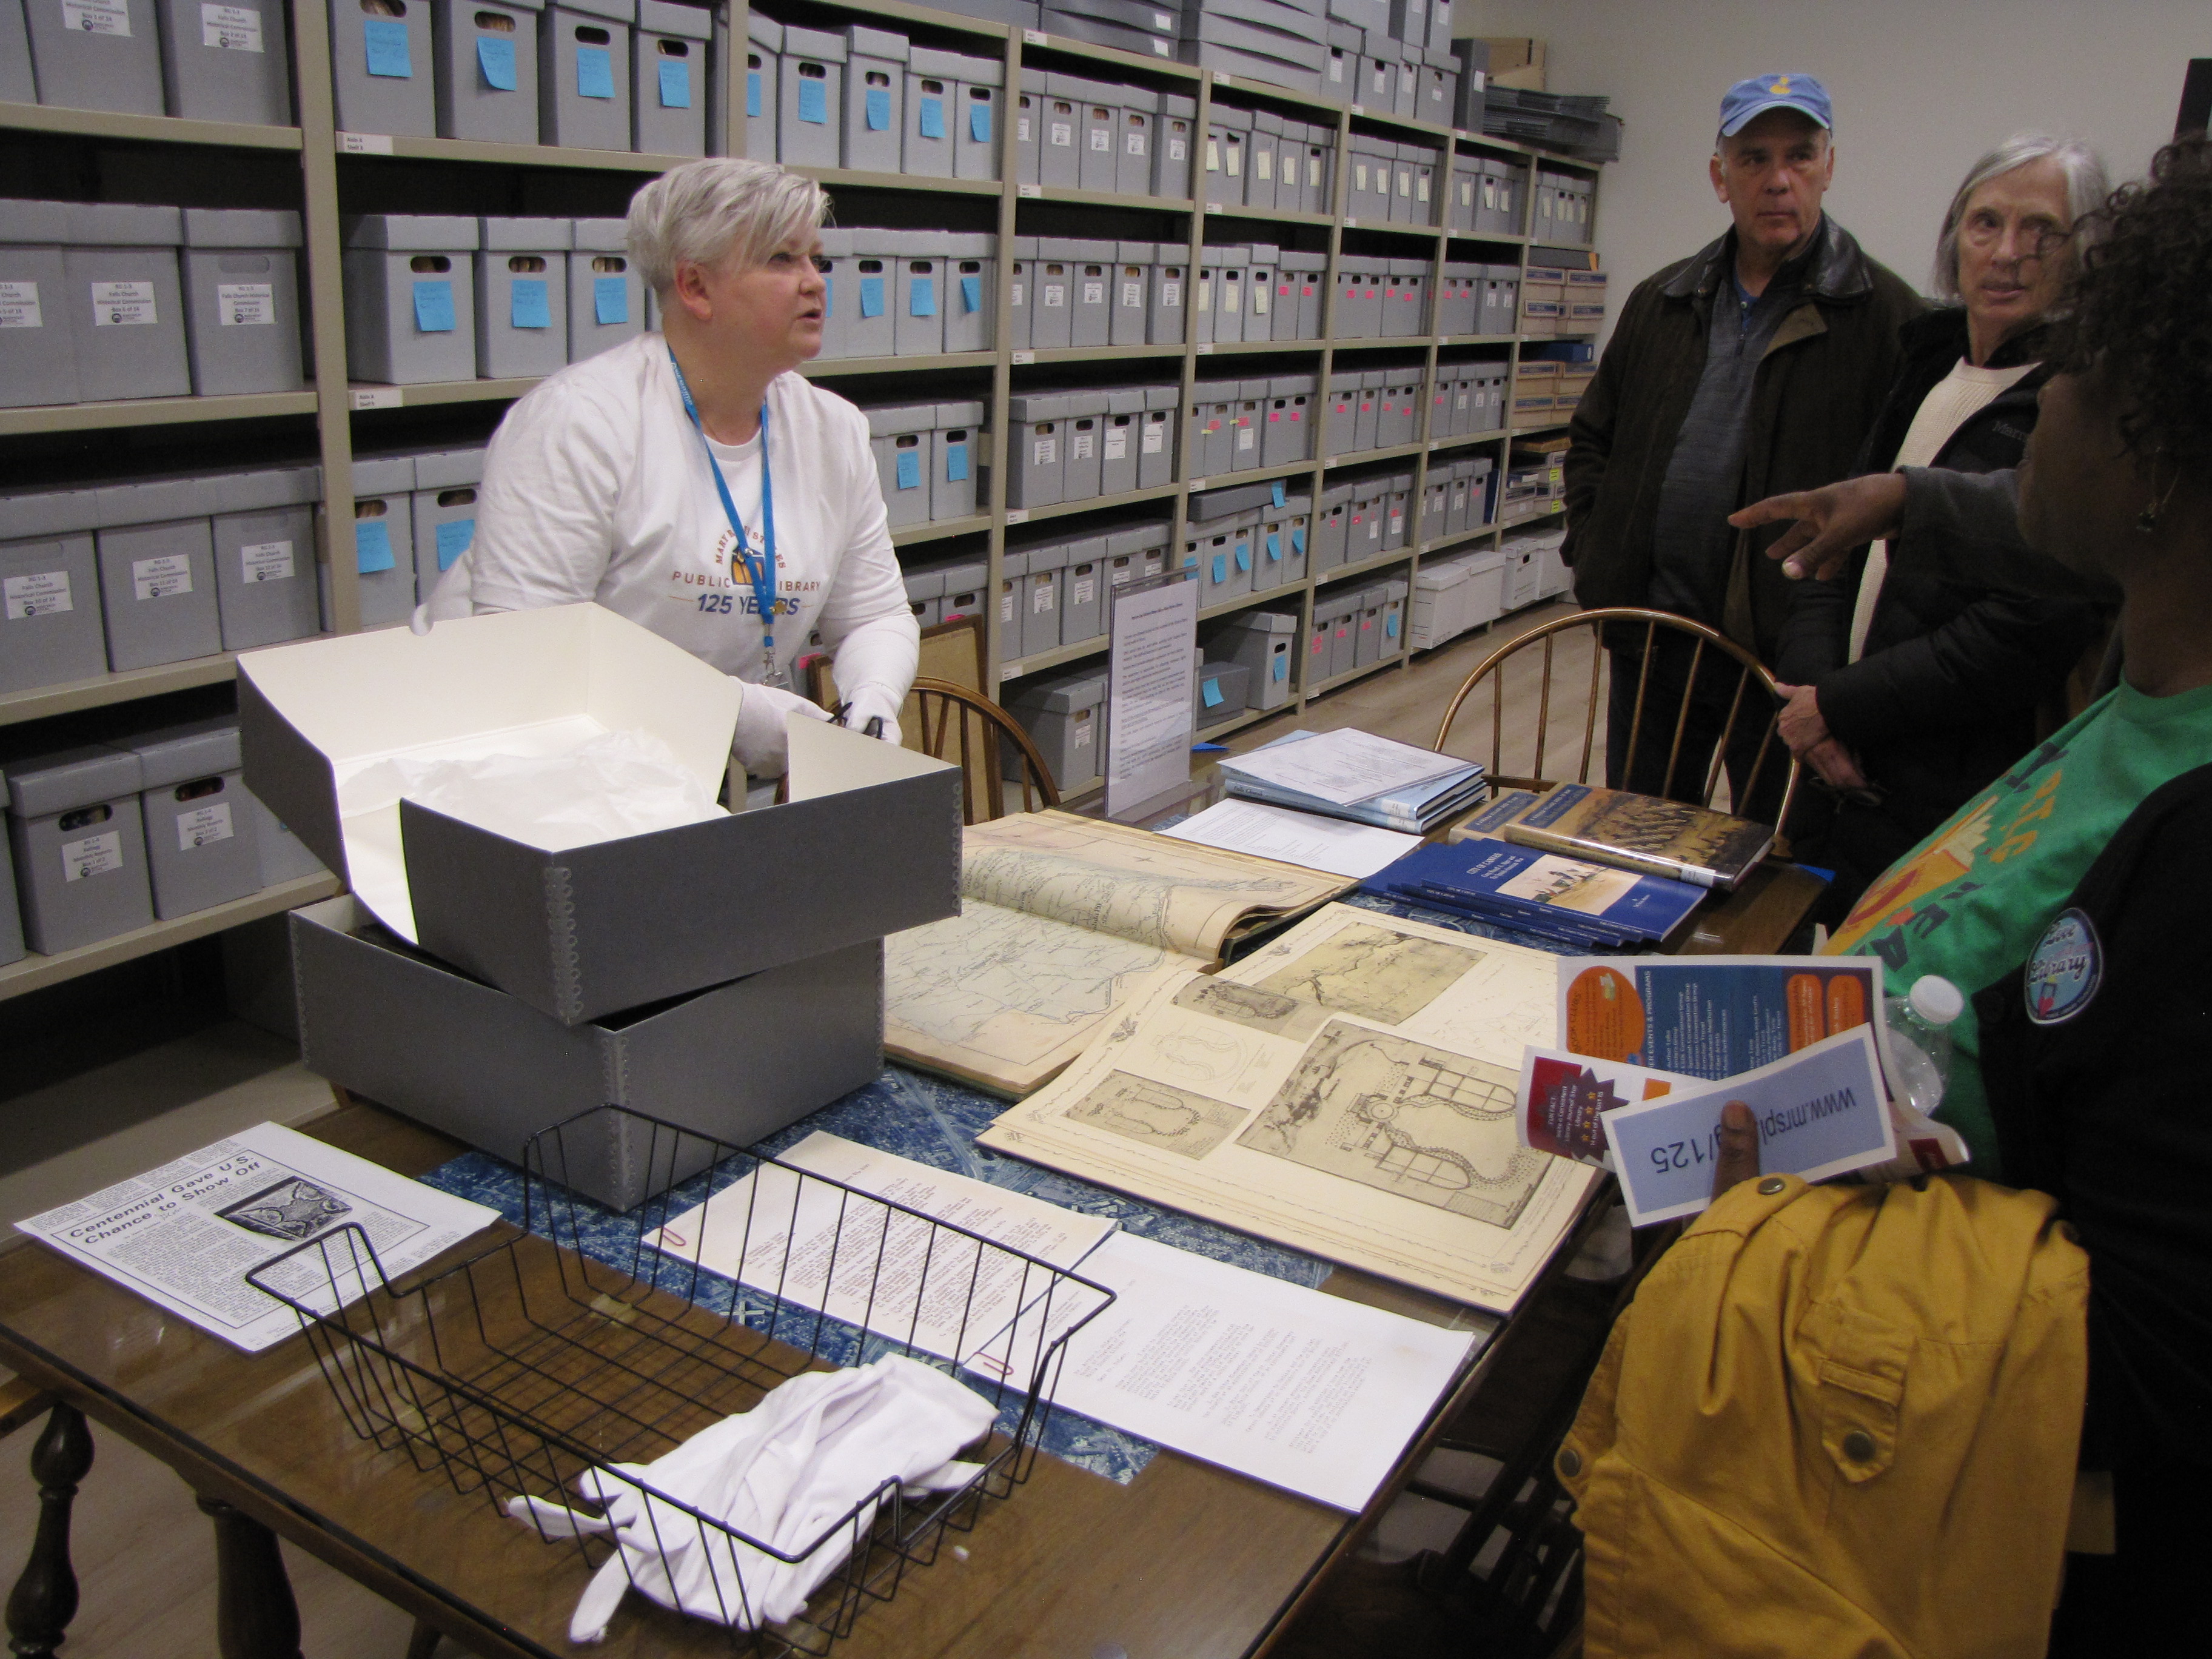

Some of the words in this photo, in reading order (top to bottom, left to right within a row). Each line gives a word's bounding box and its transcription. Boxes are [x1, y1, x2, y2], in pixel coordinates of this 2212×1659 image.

[672, 571, 731, 588] PUBLIC
[779, 580, 822, 592] IBRARY
[697, 593, 734, 615] 125
[1643, 970, 1653, 1014] PROGRAMS
[1549, 1096, 1557, 1112] FACT
[1558, 1085, 1567, 1118] Consistent
[1575, 1106, 1583, 1127] Library
[1564, 1122, 1573, 1142] Library
[70, 1192, 166, 1238] Centennial
[171, 1171, 213, 1193] Gave
[218, 1156, 255, 1172] U.S.
[85, 1212, 153, 1244] Chance
[158, 1201, 177, 1212] to
[181, 1176, 230, 1201] Show
[235, 1161, 261, 1176] Off
